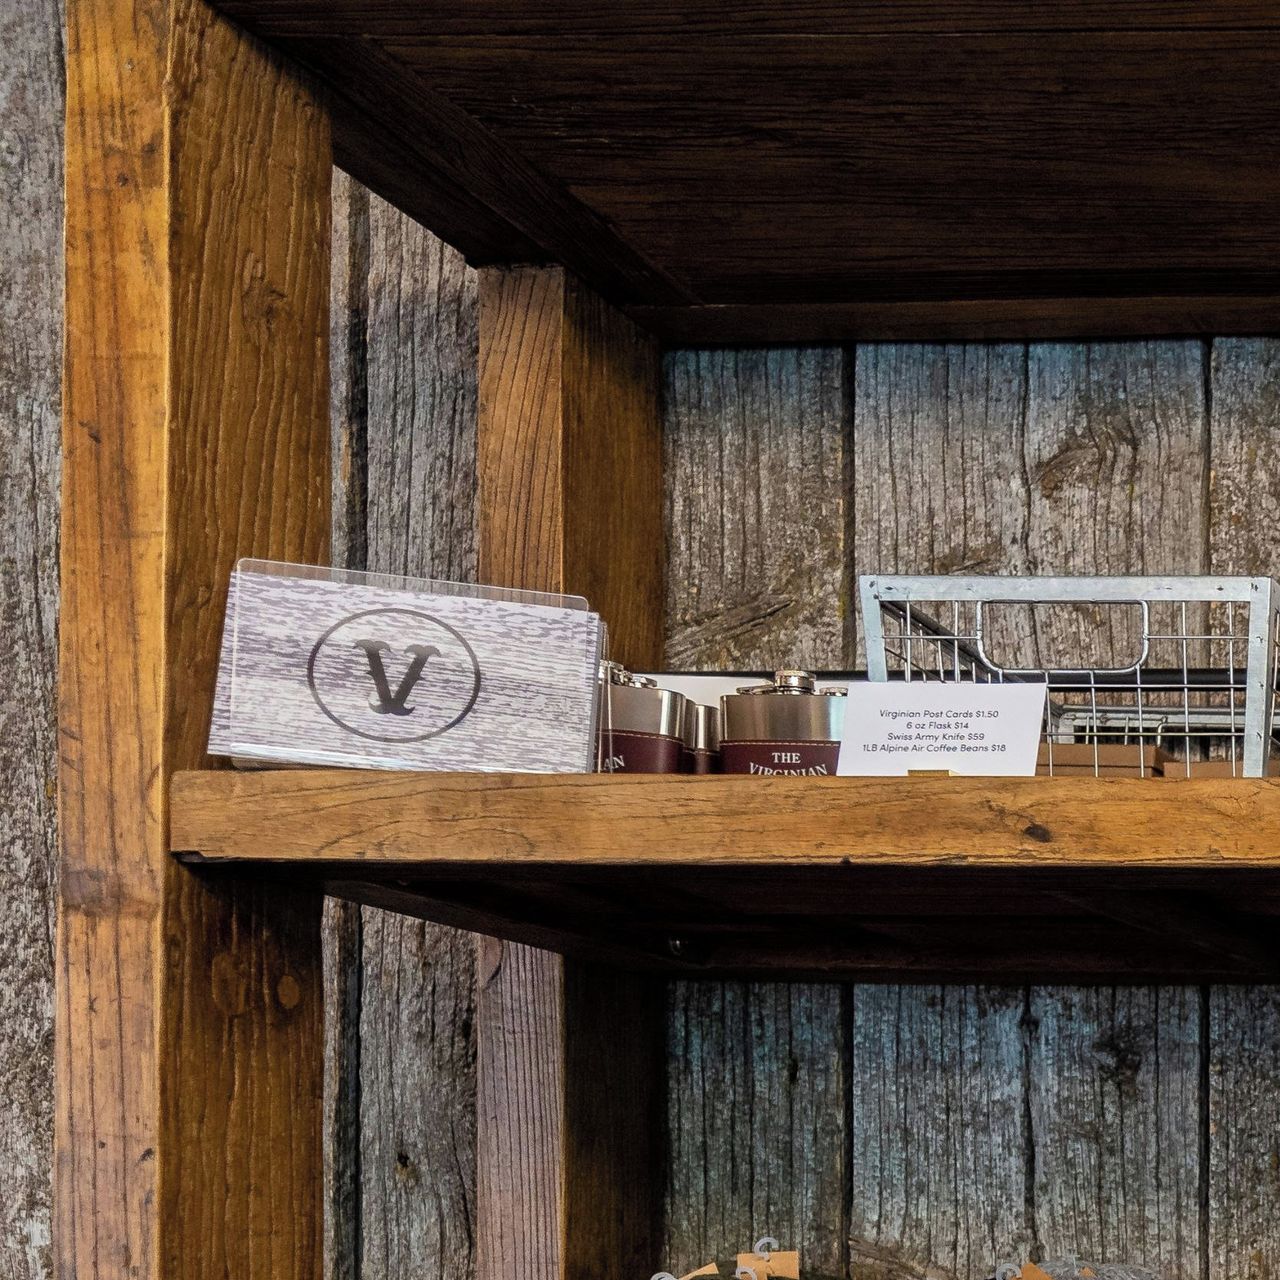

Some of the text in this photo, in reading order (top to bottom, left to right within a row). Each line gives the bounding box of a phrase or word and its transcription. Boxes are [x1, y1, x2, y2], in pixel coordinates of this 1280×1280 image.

[353, 639, 441, 715] V
[879, 709, 999, 720] Virginian Post Cards $1.50
[929, 722, 952, 730] Flask
[954, 721, 969, 730] $14
[887, 732, 985, 742] Swiss Army Knife $59
[863, 744, 1006, 753] 1LB Alpine Air Coffee Beans $18
